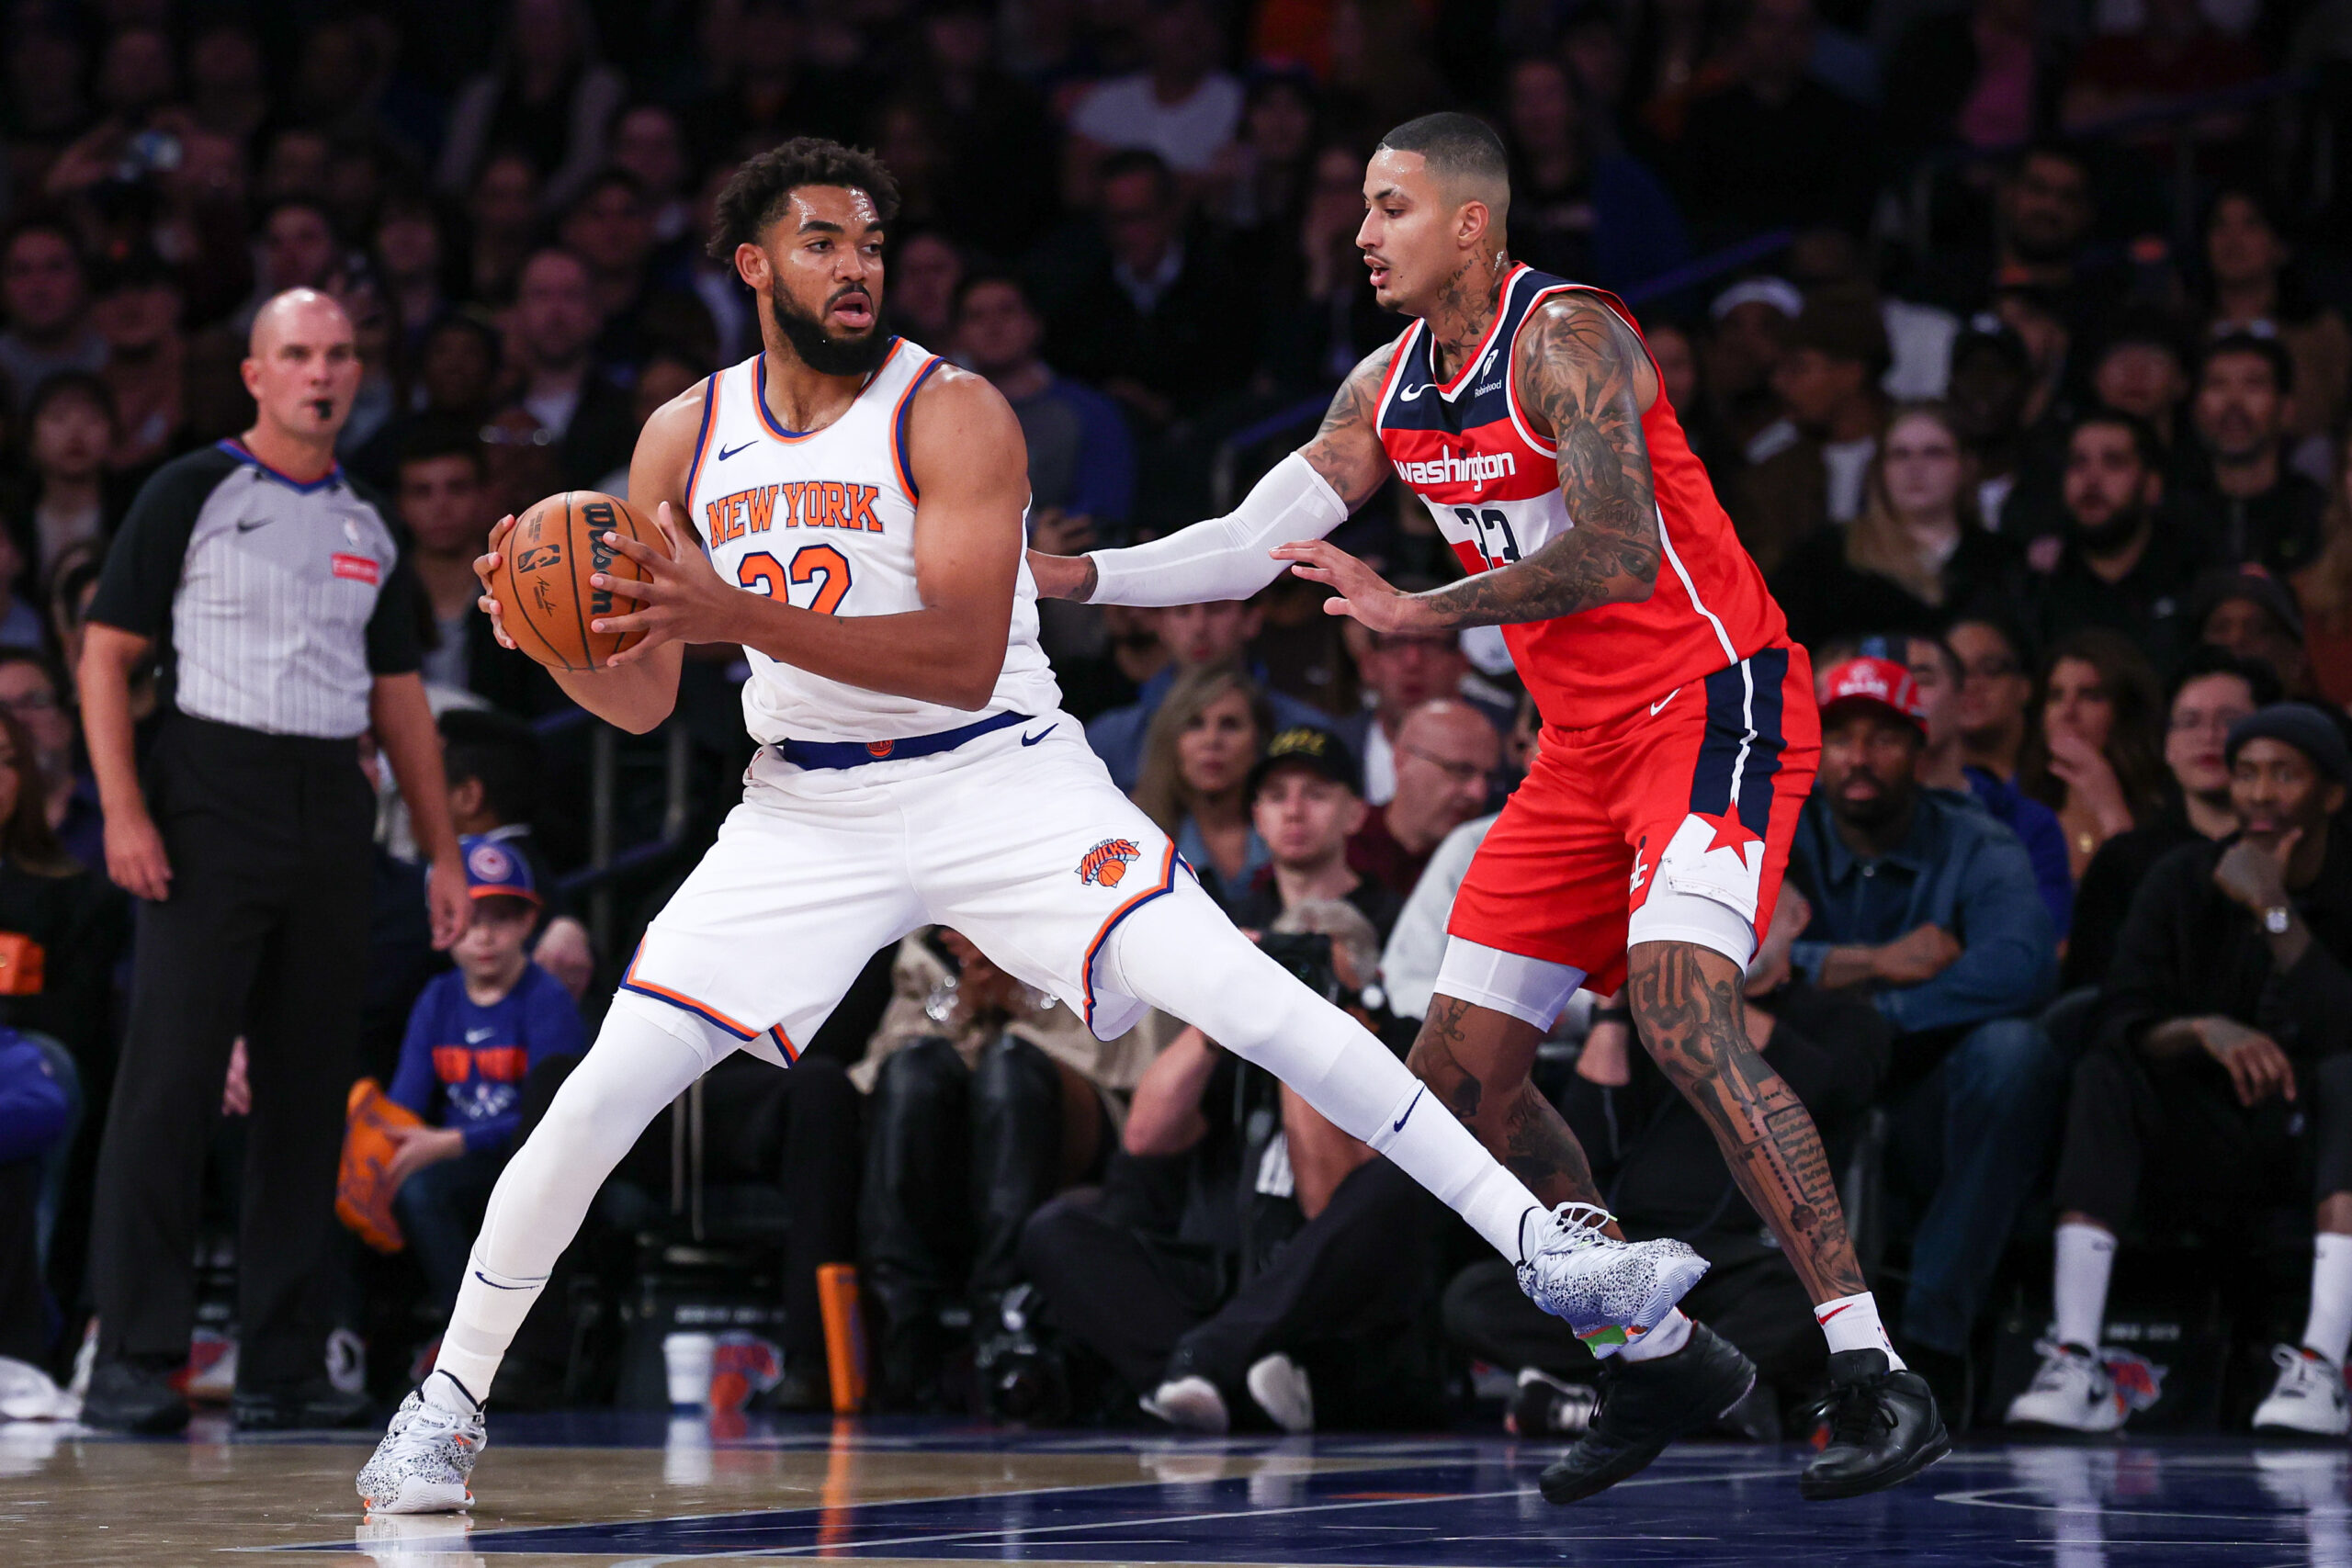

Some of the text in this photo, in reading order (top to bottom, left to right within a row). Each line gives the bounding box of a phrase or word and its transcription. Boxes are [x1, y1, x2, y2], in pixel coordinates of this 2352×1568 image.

[707, 480, 885, 550] NEW YORK
[1080, 838, 1141, 886] KNICKS
